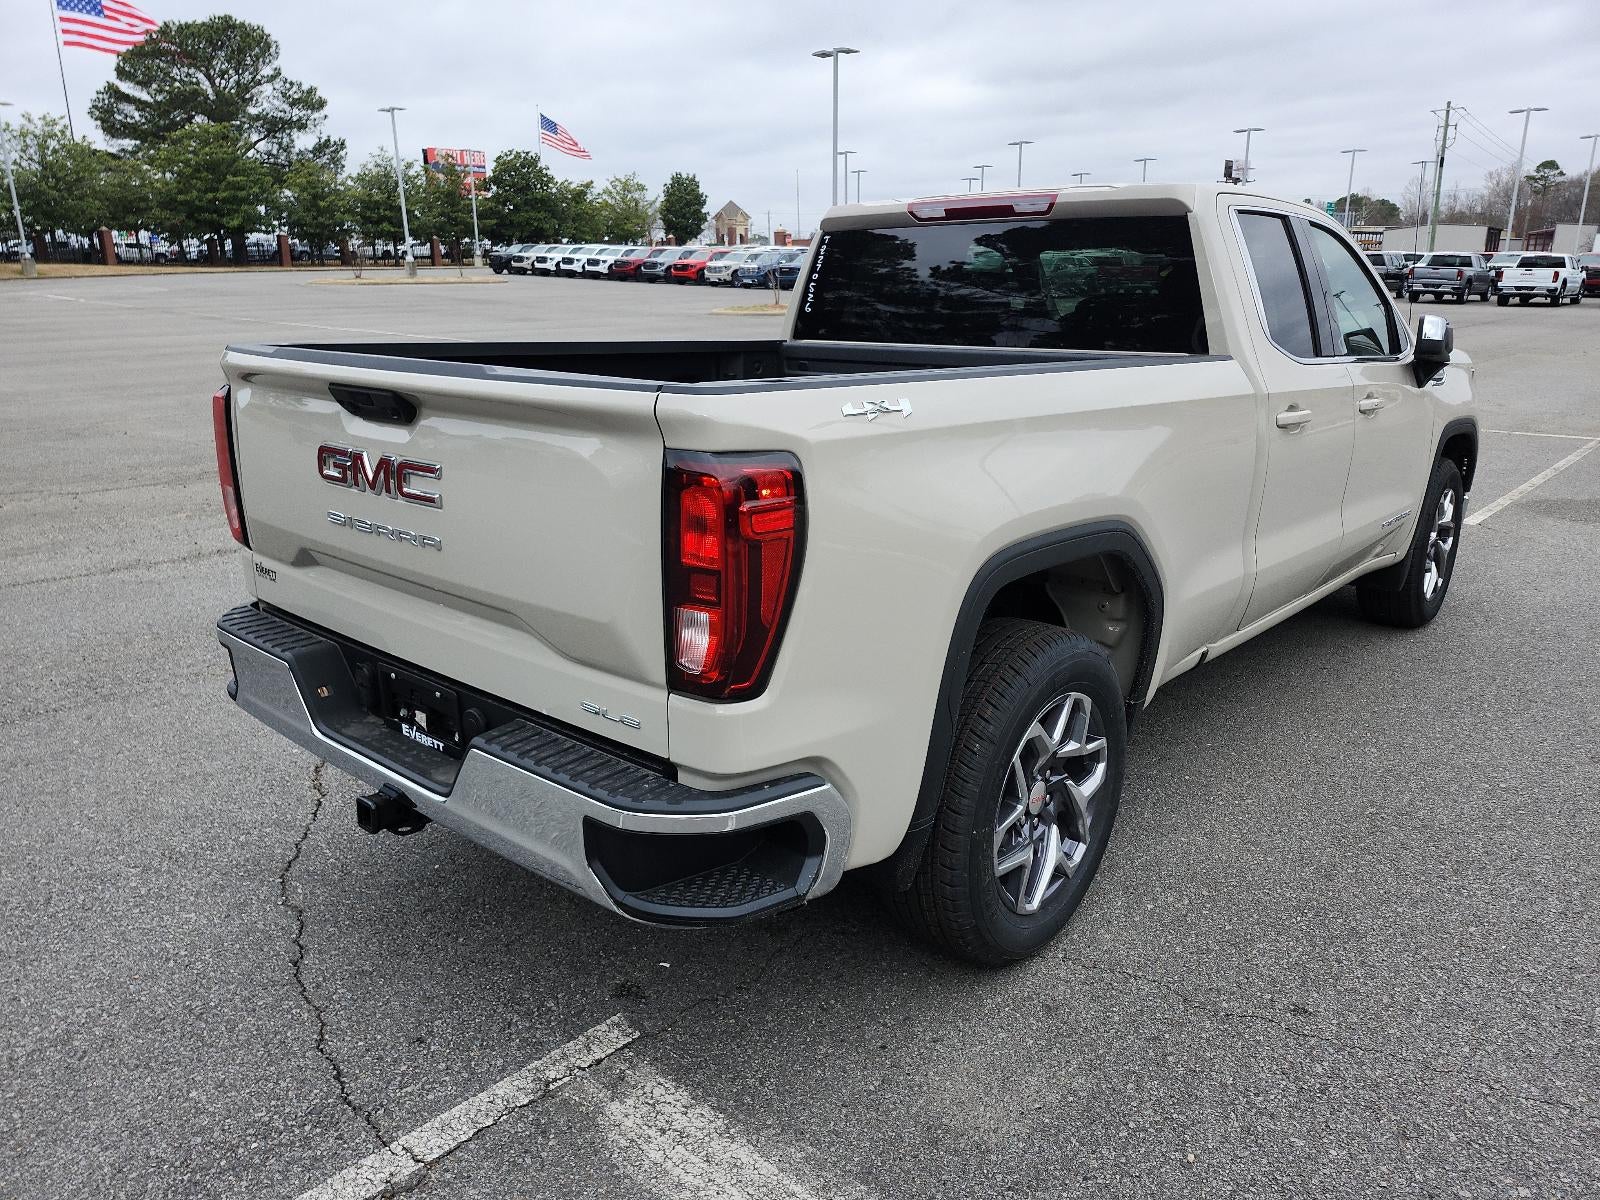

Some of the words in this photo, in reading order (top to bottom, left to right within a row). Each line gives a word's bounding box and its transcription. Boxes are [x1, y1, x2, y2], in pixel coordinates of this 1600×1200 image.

[464, 150, 485, 166] HERE
[317, 442, 443, 509] GMC
[327, 509, 442, 551] SIERRA
[580, 700, 641, 729] SLE
[401, 723, 445, 752] EVERETT
